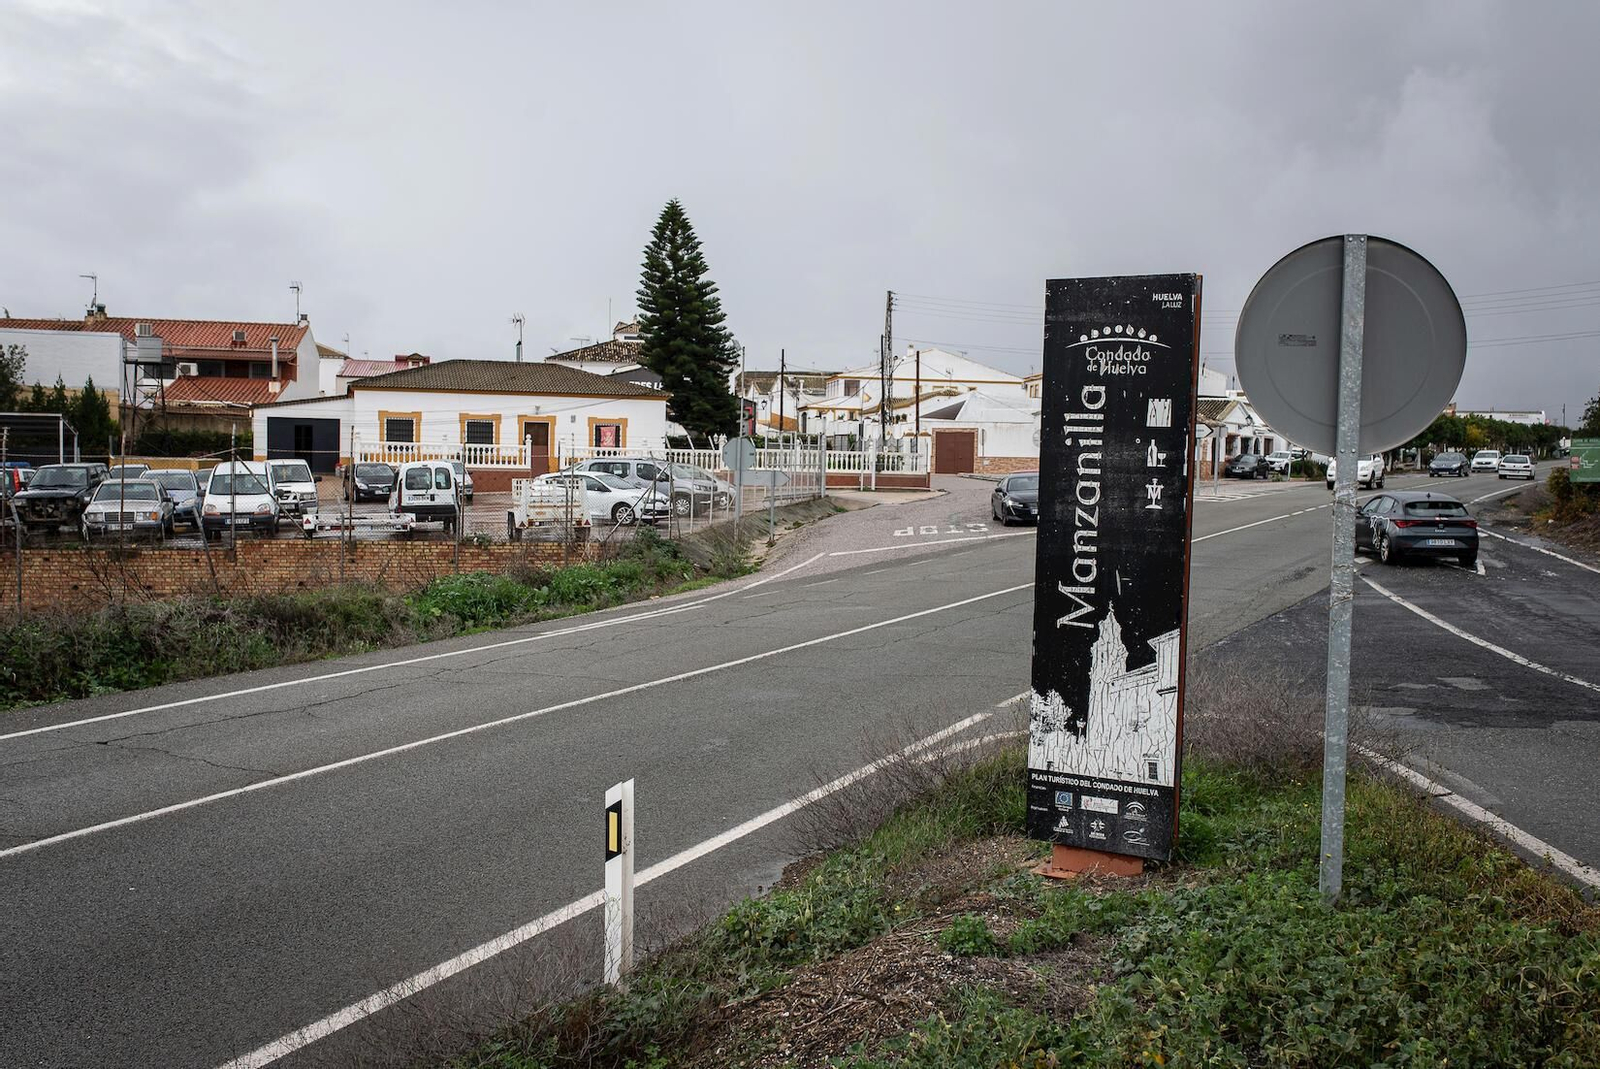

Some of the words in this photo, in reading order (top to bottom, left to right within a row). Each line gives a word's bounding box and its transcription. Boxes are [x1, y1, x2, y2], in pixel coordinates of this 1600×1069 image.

[1152, 293, 1183, 301] HUELVA
[1085, 344, 1150, 361] Condado
[1087, 360, 1098, 372] de
[1099, 359, 1147, 376] Huelva
[1057, 384, 1106, 629] Manzanilla
[893, 523, 989, 537] STOP
[1031, 773, 1048, 782] PLAN
[1048, 774, 1079, 786] TURÍSTICO
[1080, 780, 1092, 788] DEL
[1092, 781, 1123, 792] CONDADO
[1124, 786, 1133, 794] DE
[1133, 787, 1159, 797] HUELVA
